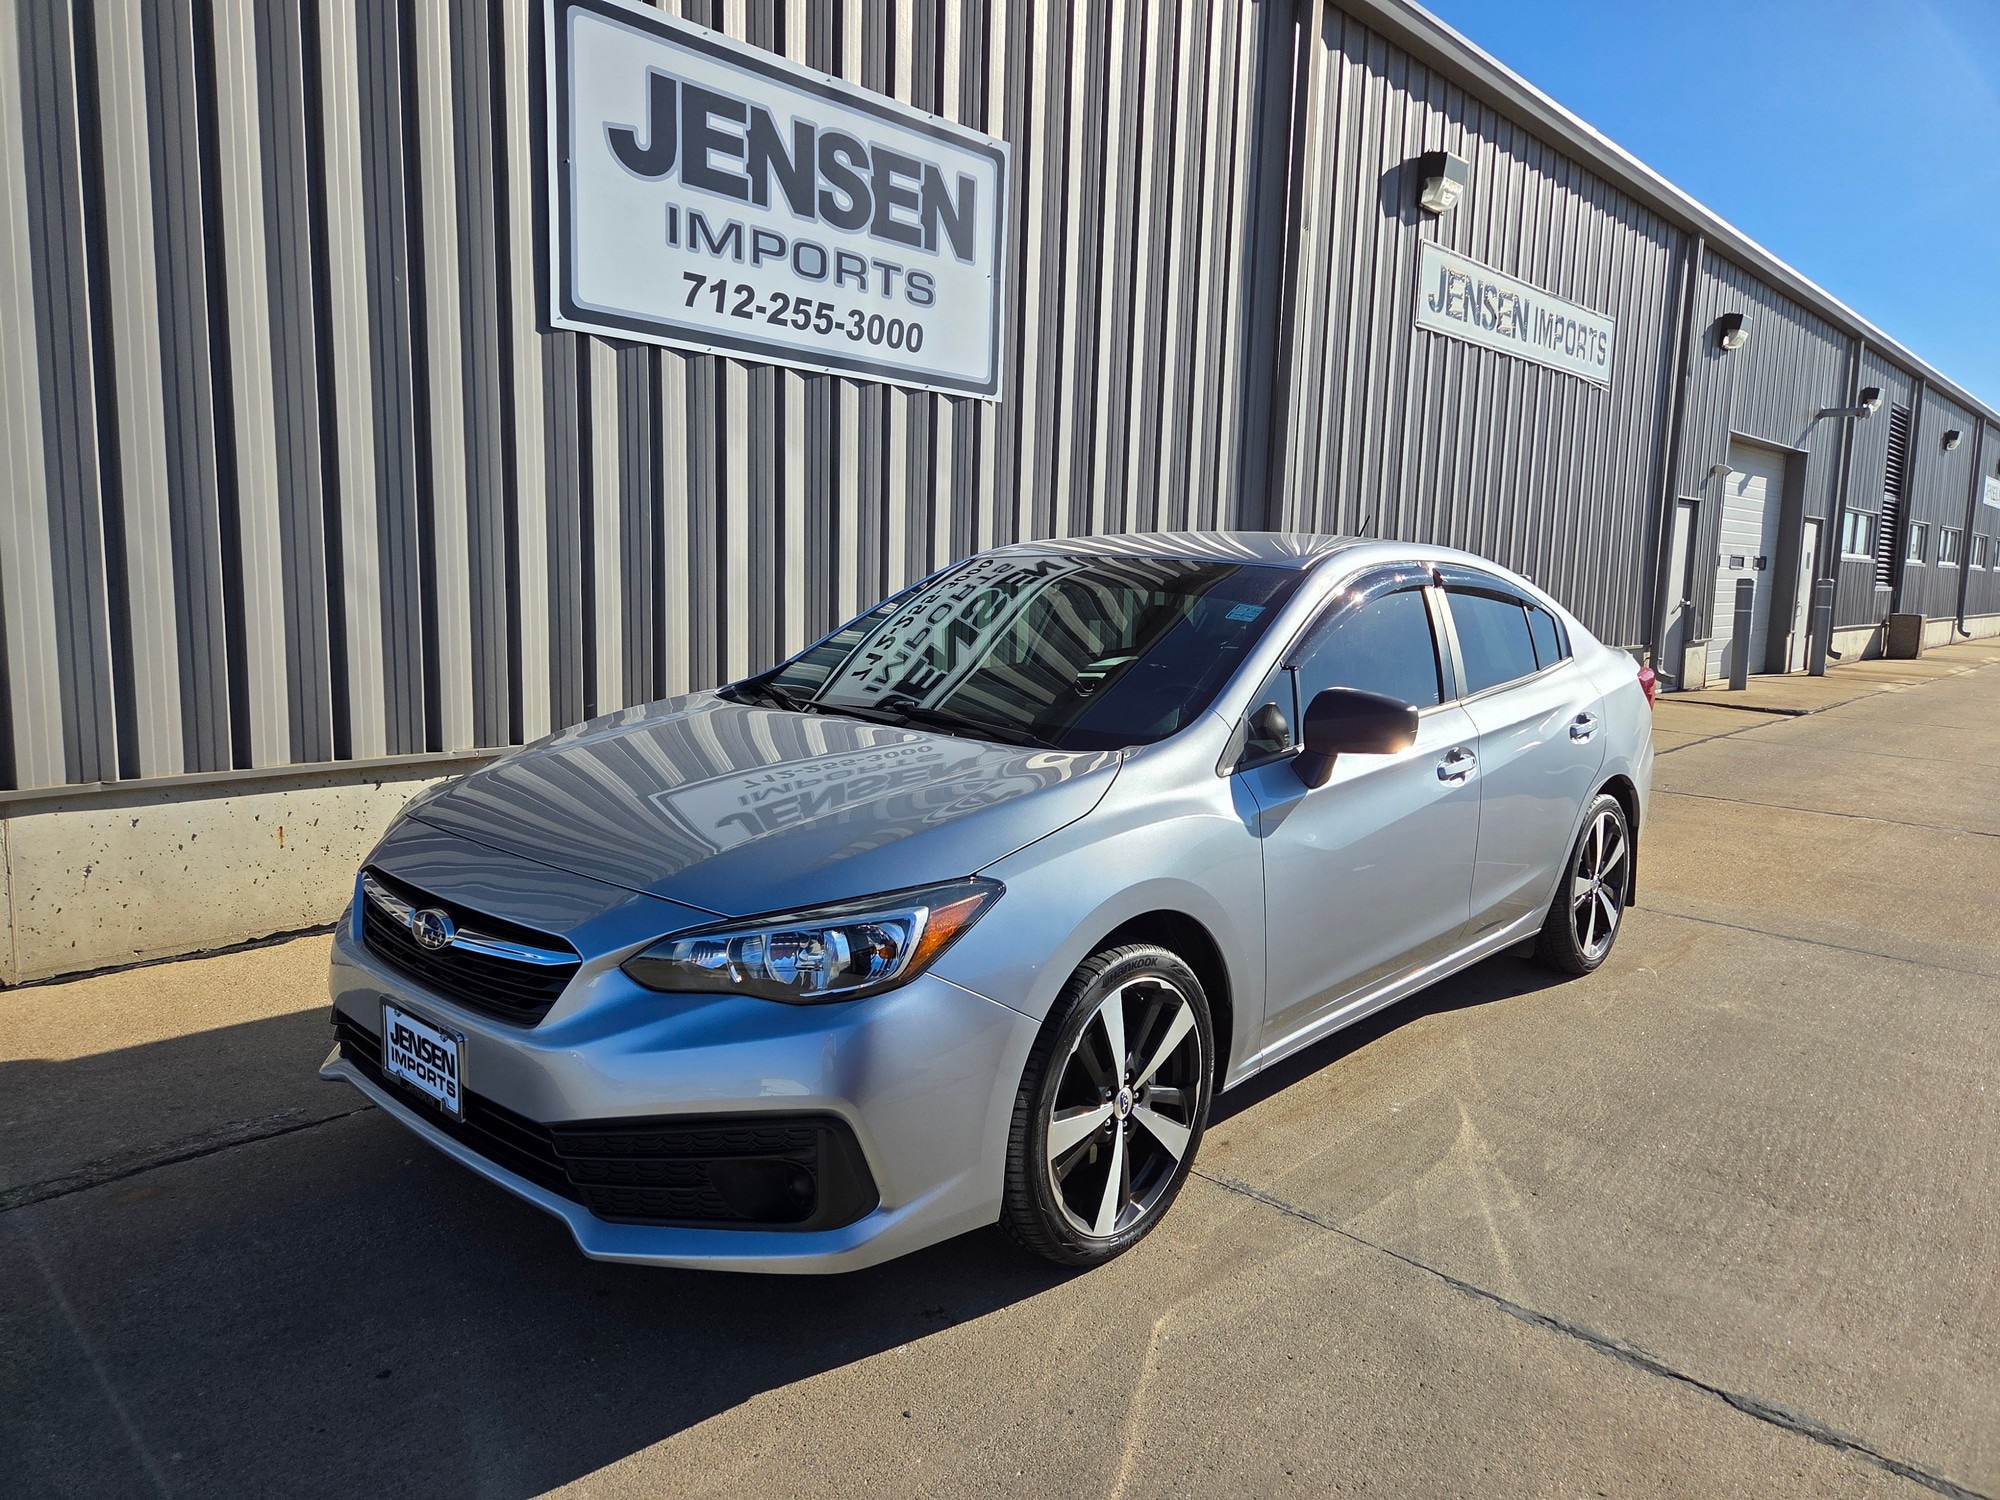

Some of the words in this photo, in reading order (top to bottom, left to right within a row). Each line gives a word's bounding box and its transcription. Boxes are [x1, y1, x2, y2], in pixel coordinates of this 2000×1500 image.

[603, 65, 977, 266] JENSEN
[665, 202, 937, 308] IMPORTS
[682, 272, 924, 353] 712-255-3000
[1428, 265, 1530, 342] JENSEN
[1533, 307, 1607, 366] IMPORTS
[390, 1022, 456, 1079] JENSEN
[391, 1046, 456, 1098] IMPORTS
